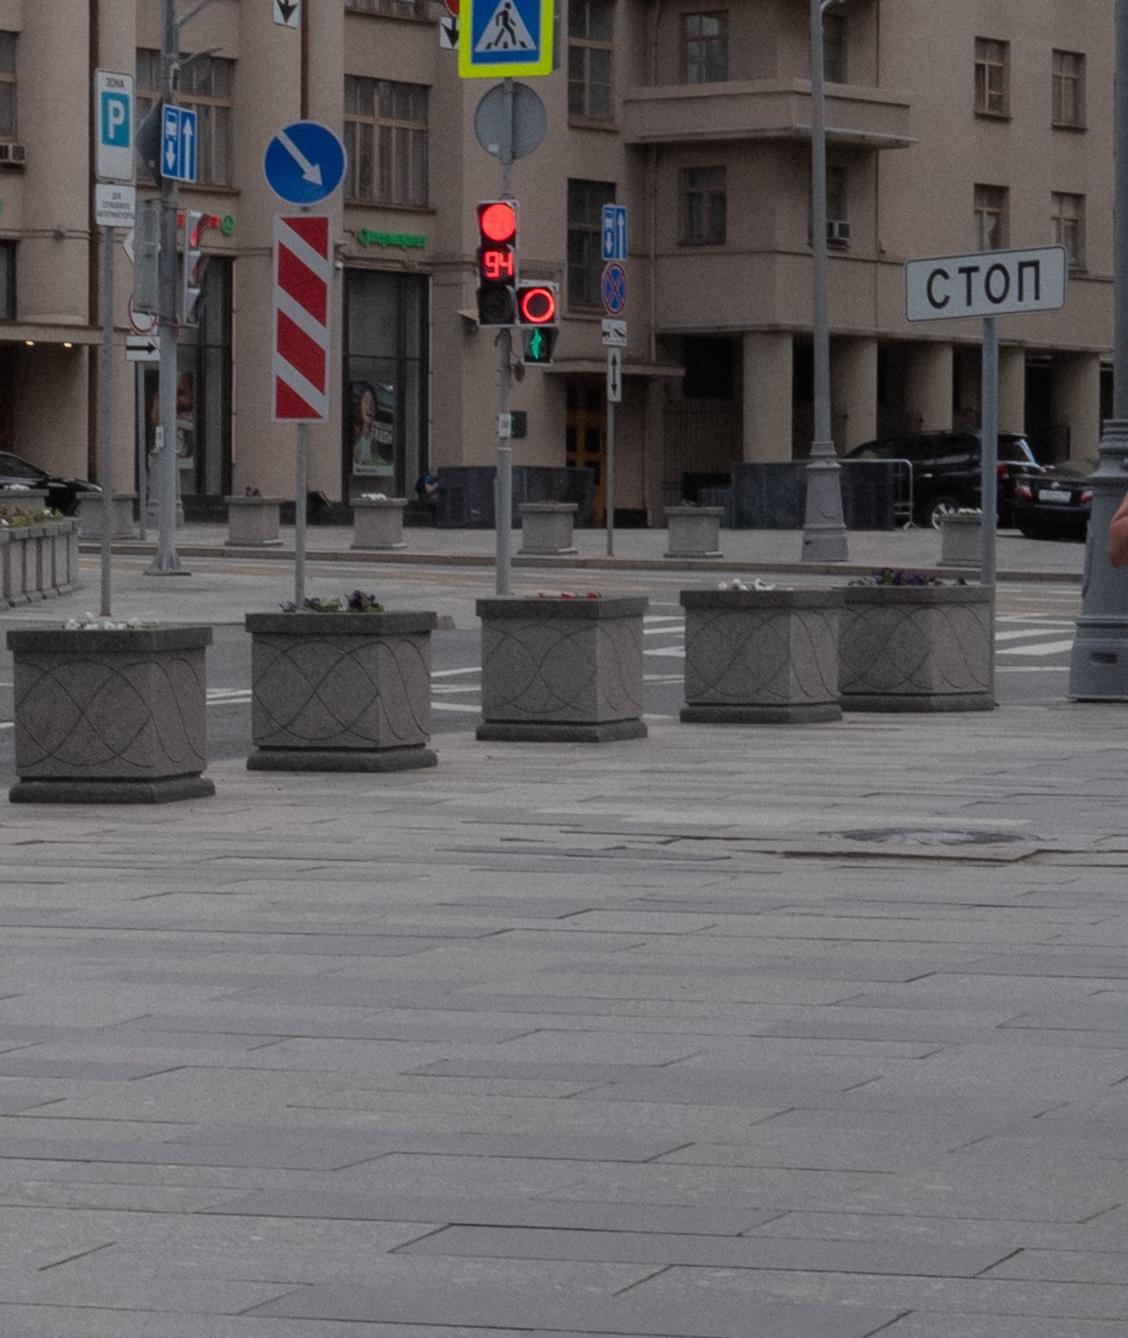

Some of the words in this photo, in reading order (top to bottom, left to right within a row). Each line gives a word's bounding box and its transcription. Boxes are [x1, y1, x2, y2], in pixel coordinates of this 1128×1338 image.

[107, 99, 125, 139] P
[483, 251, 513, 278] 94
[927, 260, 1040, 309] СТОП
